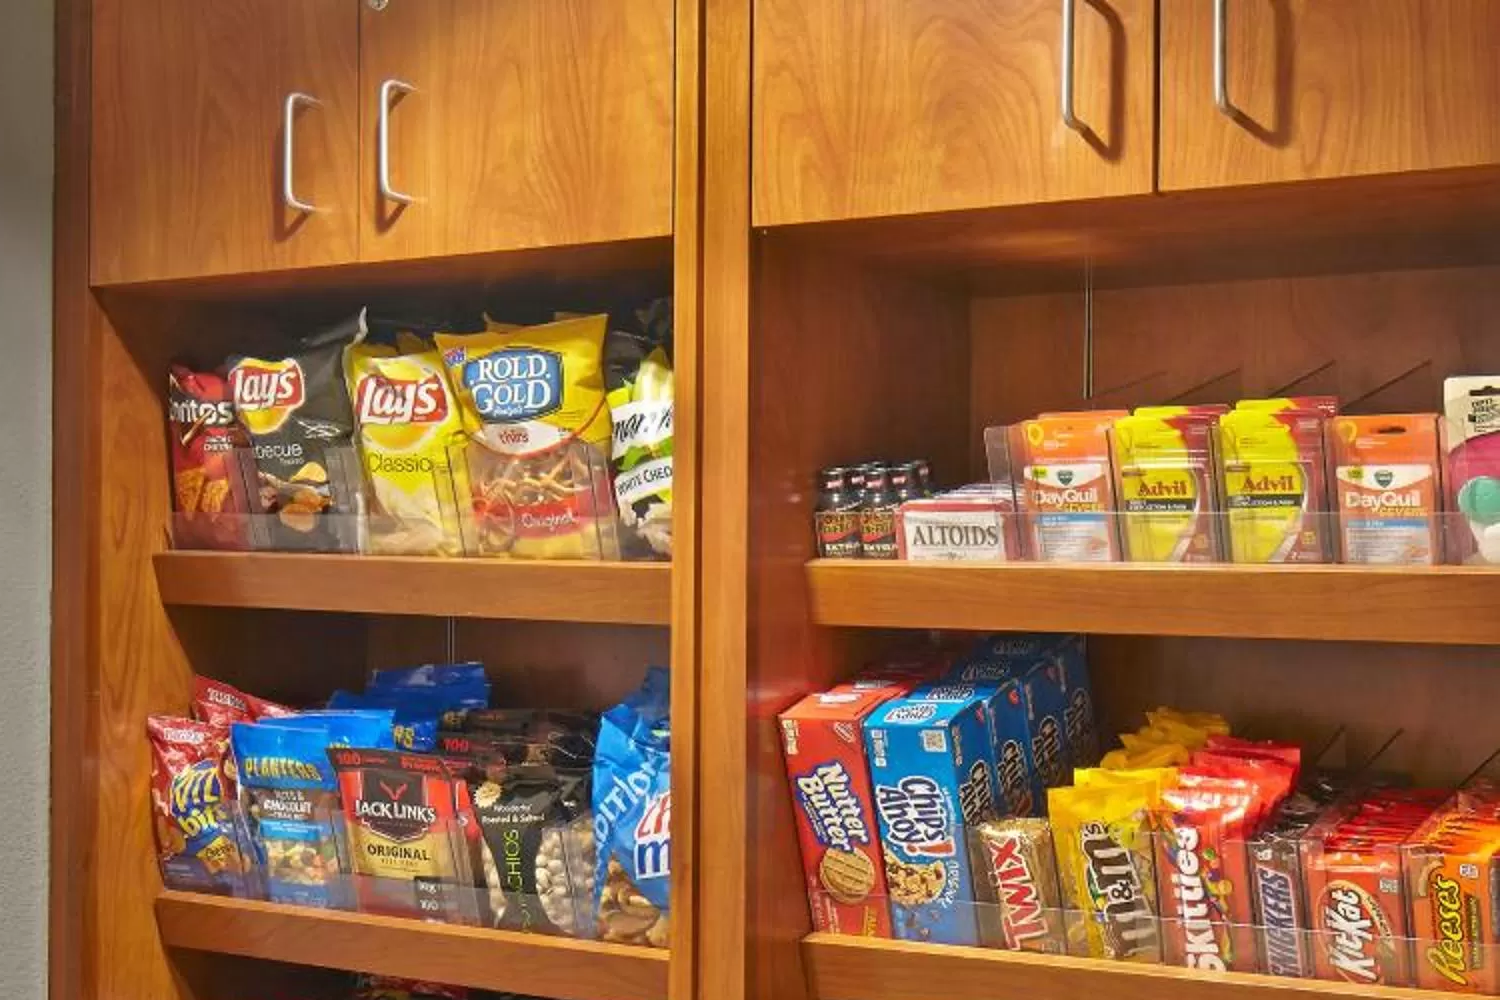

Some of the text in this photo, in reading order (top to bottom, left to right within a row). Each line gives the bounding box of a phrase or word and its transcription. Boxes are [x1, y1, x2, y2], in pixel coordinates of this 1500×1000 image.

[478, 354, 548, 382] ROLD
[471, 378, 551, 414] GOLD
[368, 450, 435, 474] Classic
[1137, 480, 1188, 497] Advil
[1241, 475, 1295, 493] Advil
[1345, 490, 1422, 512] DayQuil
[912, 525, 1000, 547] ALTOIDS
[355, 799, 393, 819] JACK
[795, 774, 852, 852] Butter
[815, 761, 869, 846] Nutter
[899, 776, 947, 843] Chips
[367, 843, 431, 861] ORIGINAL
[1171, 826, 1228, 973] Skittles
[1426, 873, 1469, 986] Reese's
